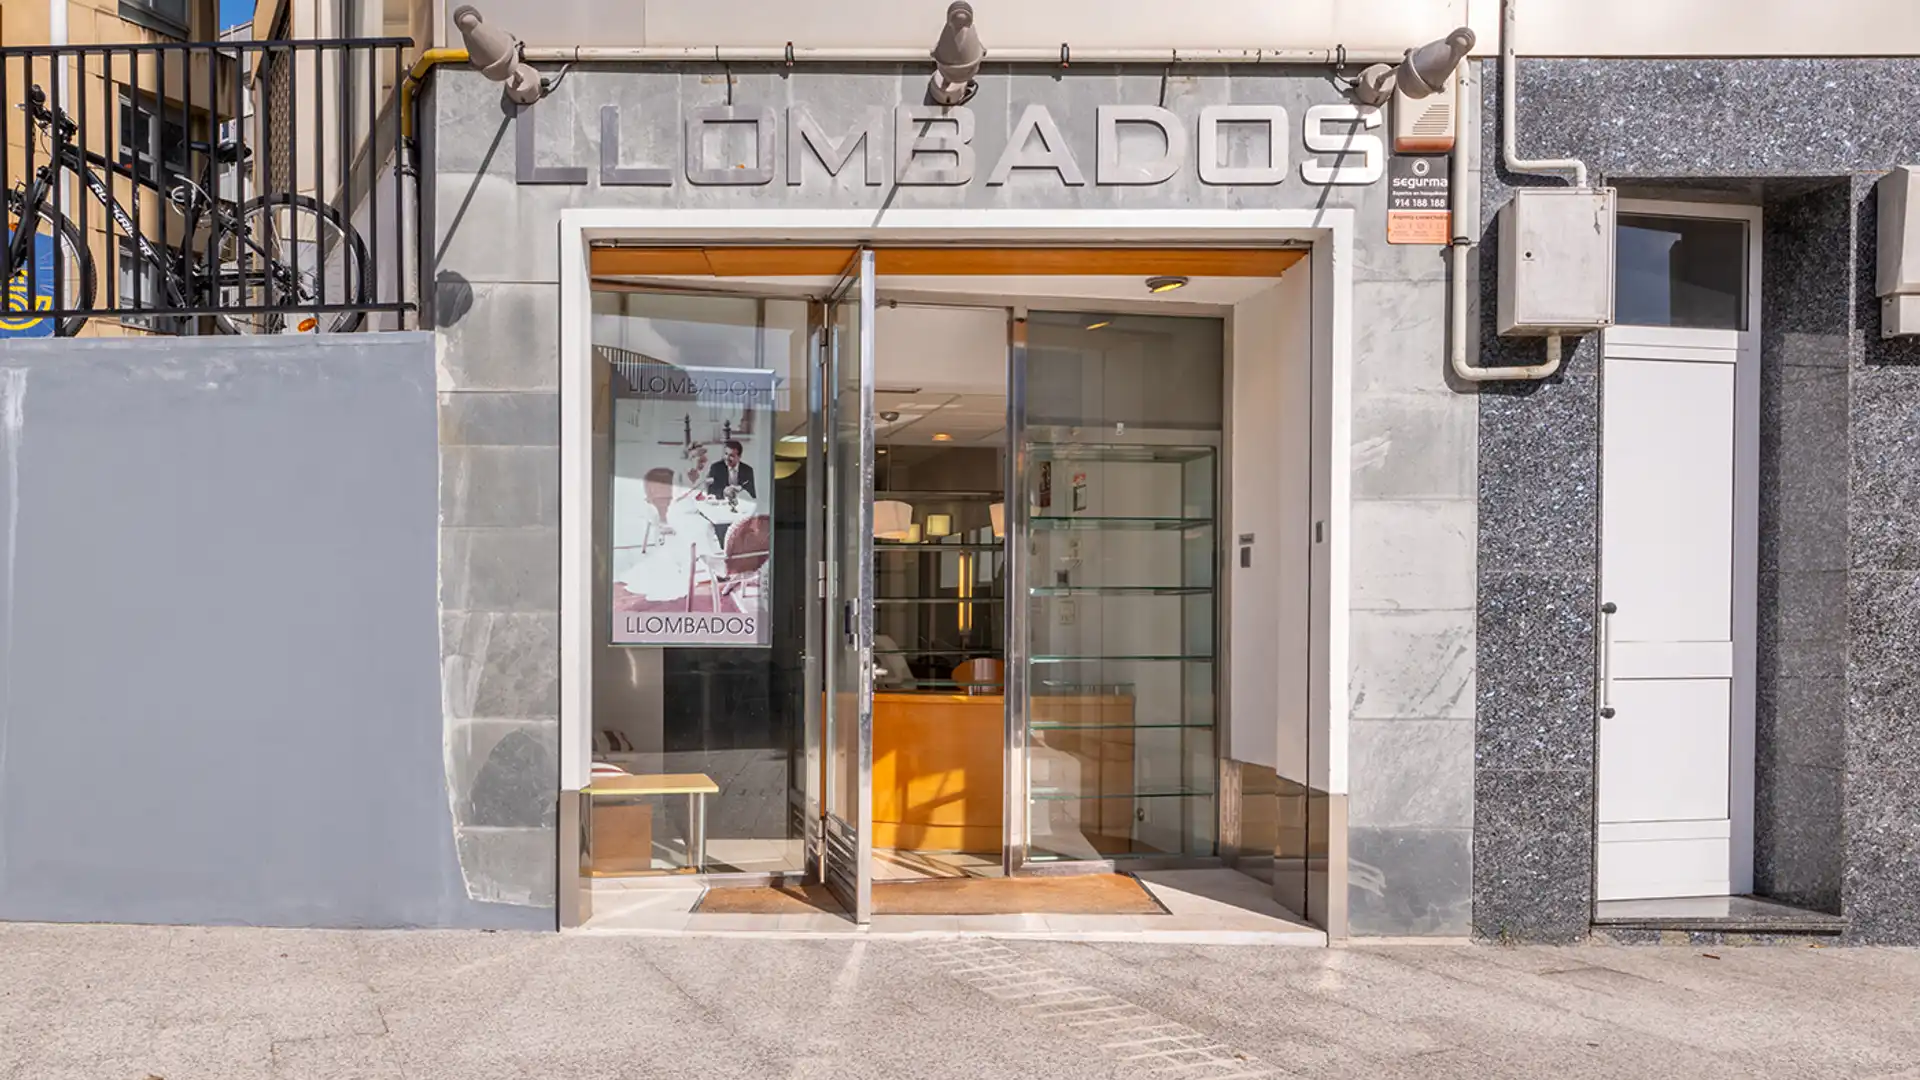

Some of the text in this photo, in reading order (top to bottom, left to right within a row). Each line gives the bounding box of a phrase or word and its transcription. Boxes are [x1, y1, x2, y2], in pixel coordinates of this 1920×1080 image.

[516, 104, 1384, 185] LLOMBADOS
[1393, 178, 1448, 189] segurma
[1395, 198, 1446, 207] 914 188 188
[629, 374, 760, 397] LLOMBADOS
[626, 616, 756, 635] LLOMBADOS
